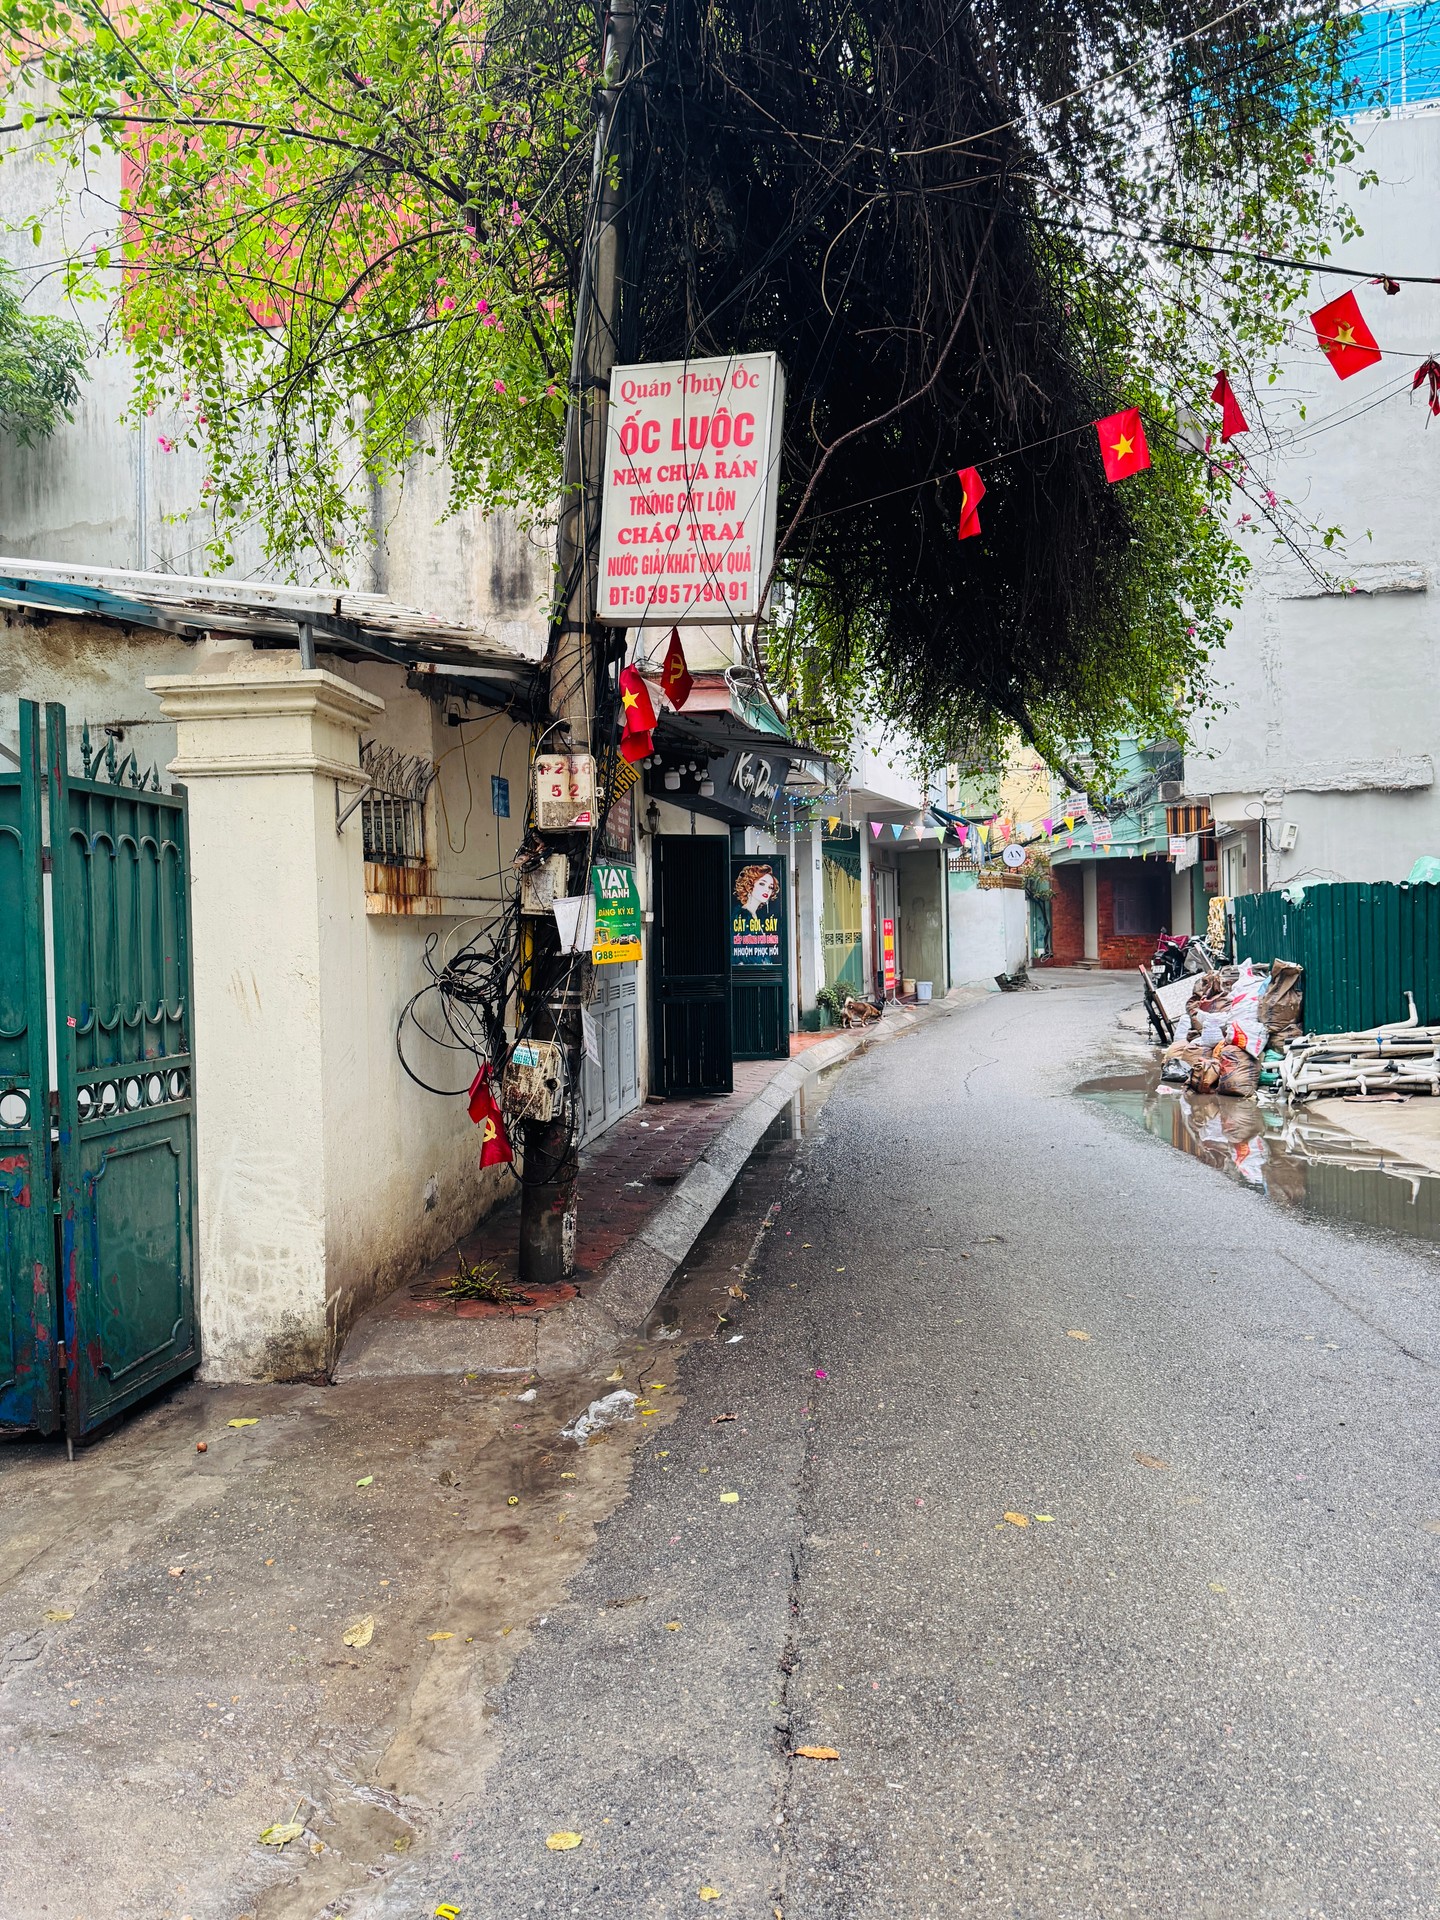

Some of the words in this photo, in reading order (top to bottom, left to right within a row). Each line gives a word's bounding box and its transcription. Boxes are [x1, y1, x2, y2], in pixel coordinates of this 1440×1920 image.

[620, 378, 672, 406] Quán
[677, 371, 724, 397] Thủy
[731, 362, 761, 390] Ốc
[619, 409, 661, 456] ỐC
[671, 406, 756, 457] LUỘC
[612, 465, 652, 487] NEM
[656, 461, 710, 484] CHUA
[714, 453, 759, 479] RÁN
[629, 489, 675, 516] TRỨNG
[676, 487, 704, 513] CÚT
[707, 486, 737, 516] LỘN
[617, 521, 681, 545] CHÁO
[686, 521, 746, 543] TRAI
[607, 551, 639, 577] NƯỚC
[641, 547, 666, 576] GIẢI
[666, 548, 697, 575] KHÁT
[702, 550, 724, 575] HOA
[726, 545, 752, 573] QUẢ
[597, 868, 628, 890] VAY
[602, 888, 630, 899] NHANH
[598, 907, 616, 917] ĐĂNG
[618, 906, 625, 916] KÝ
[627, 907, 634, 915] XE
[733, 946, 753, 957] NHUỘM
